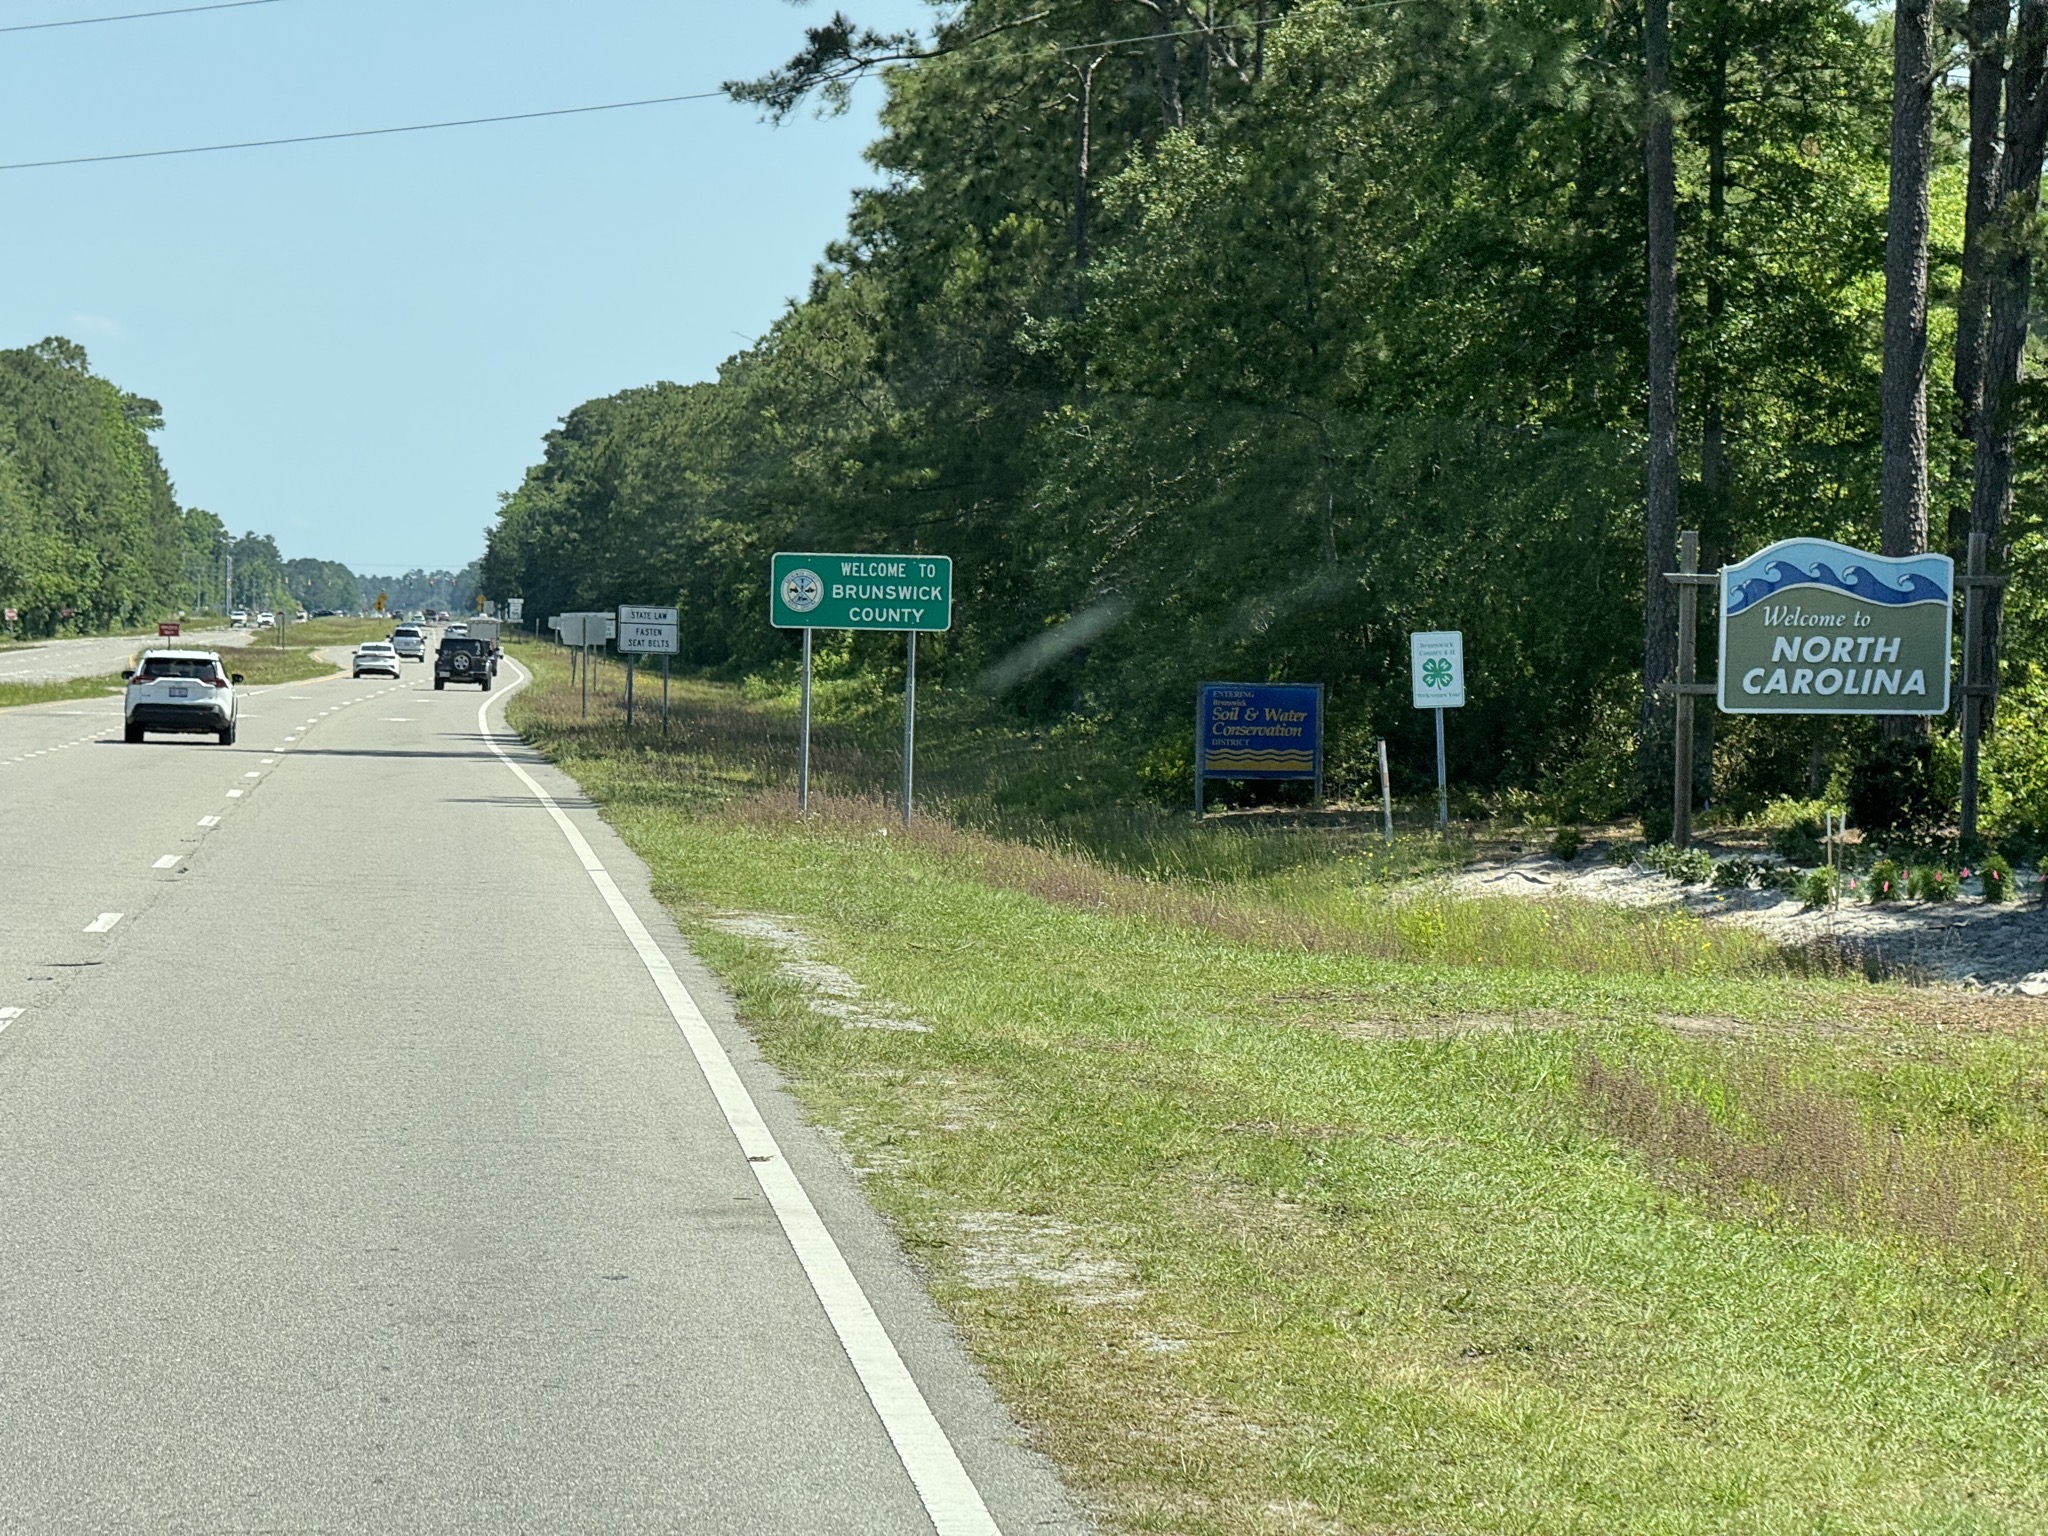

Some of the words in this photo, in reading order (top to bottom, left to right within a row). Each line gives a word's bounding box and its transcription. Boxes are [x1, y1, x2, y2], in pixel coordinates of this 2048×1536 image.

[841, 562, 906, 577] WELCOME
[919, 564, 936, 578] TO
[832, 584, 942, 601] BRUNSWICK
[630, 611, 652, 620] STATE
[654, 612, 668, 620] LAW
[849, 607, 925, 623] COUNTY
[1763, 606, 1846, 627] Welcome
[1854, 610, 1871, 627] to
[635, 627, 663, 637] FASTEN
[628, 638, 646, 648] SEAT
[647, 639, 670, 649] BELTS
[1771, 635, 1901, 664] NORTH
[1742, 667, 1927, 696] CAROLINA
[1212, 690, 1255, 698] ENTERING
[1211, 706, 1240, 721] Soil
[1243, 707, 1260, 721] &
[1263, 707, 1308, 723] Water
[1211, 721, 1303, 737] Conservation
[1211, 738, 1251, 746] DISTRICT
